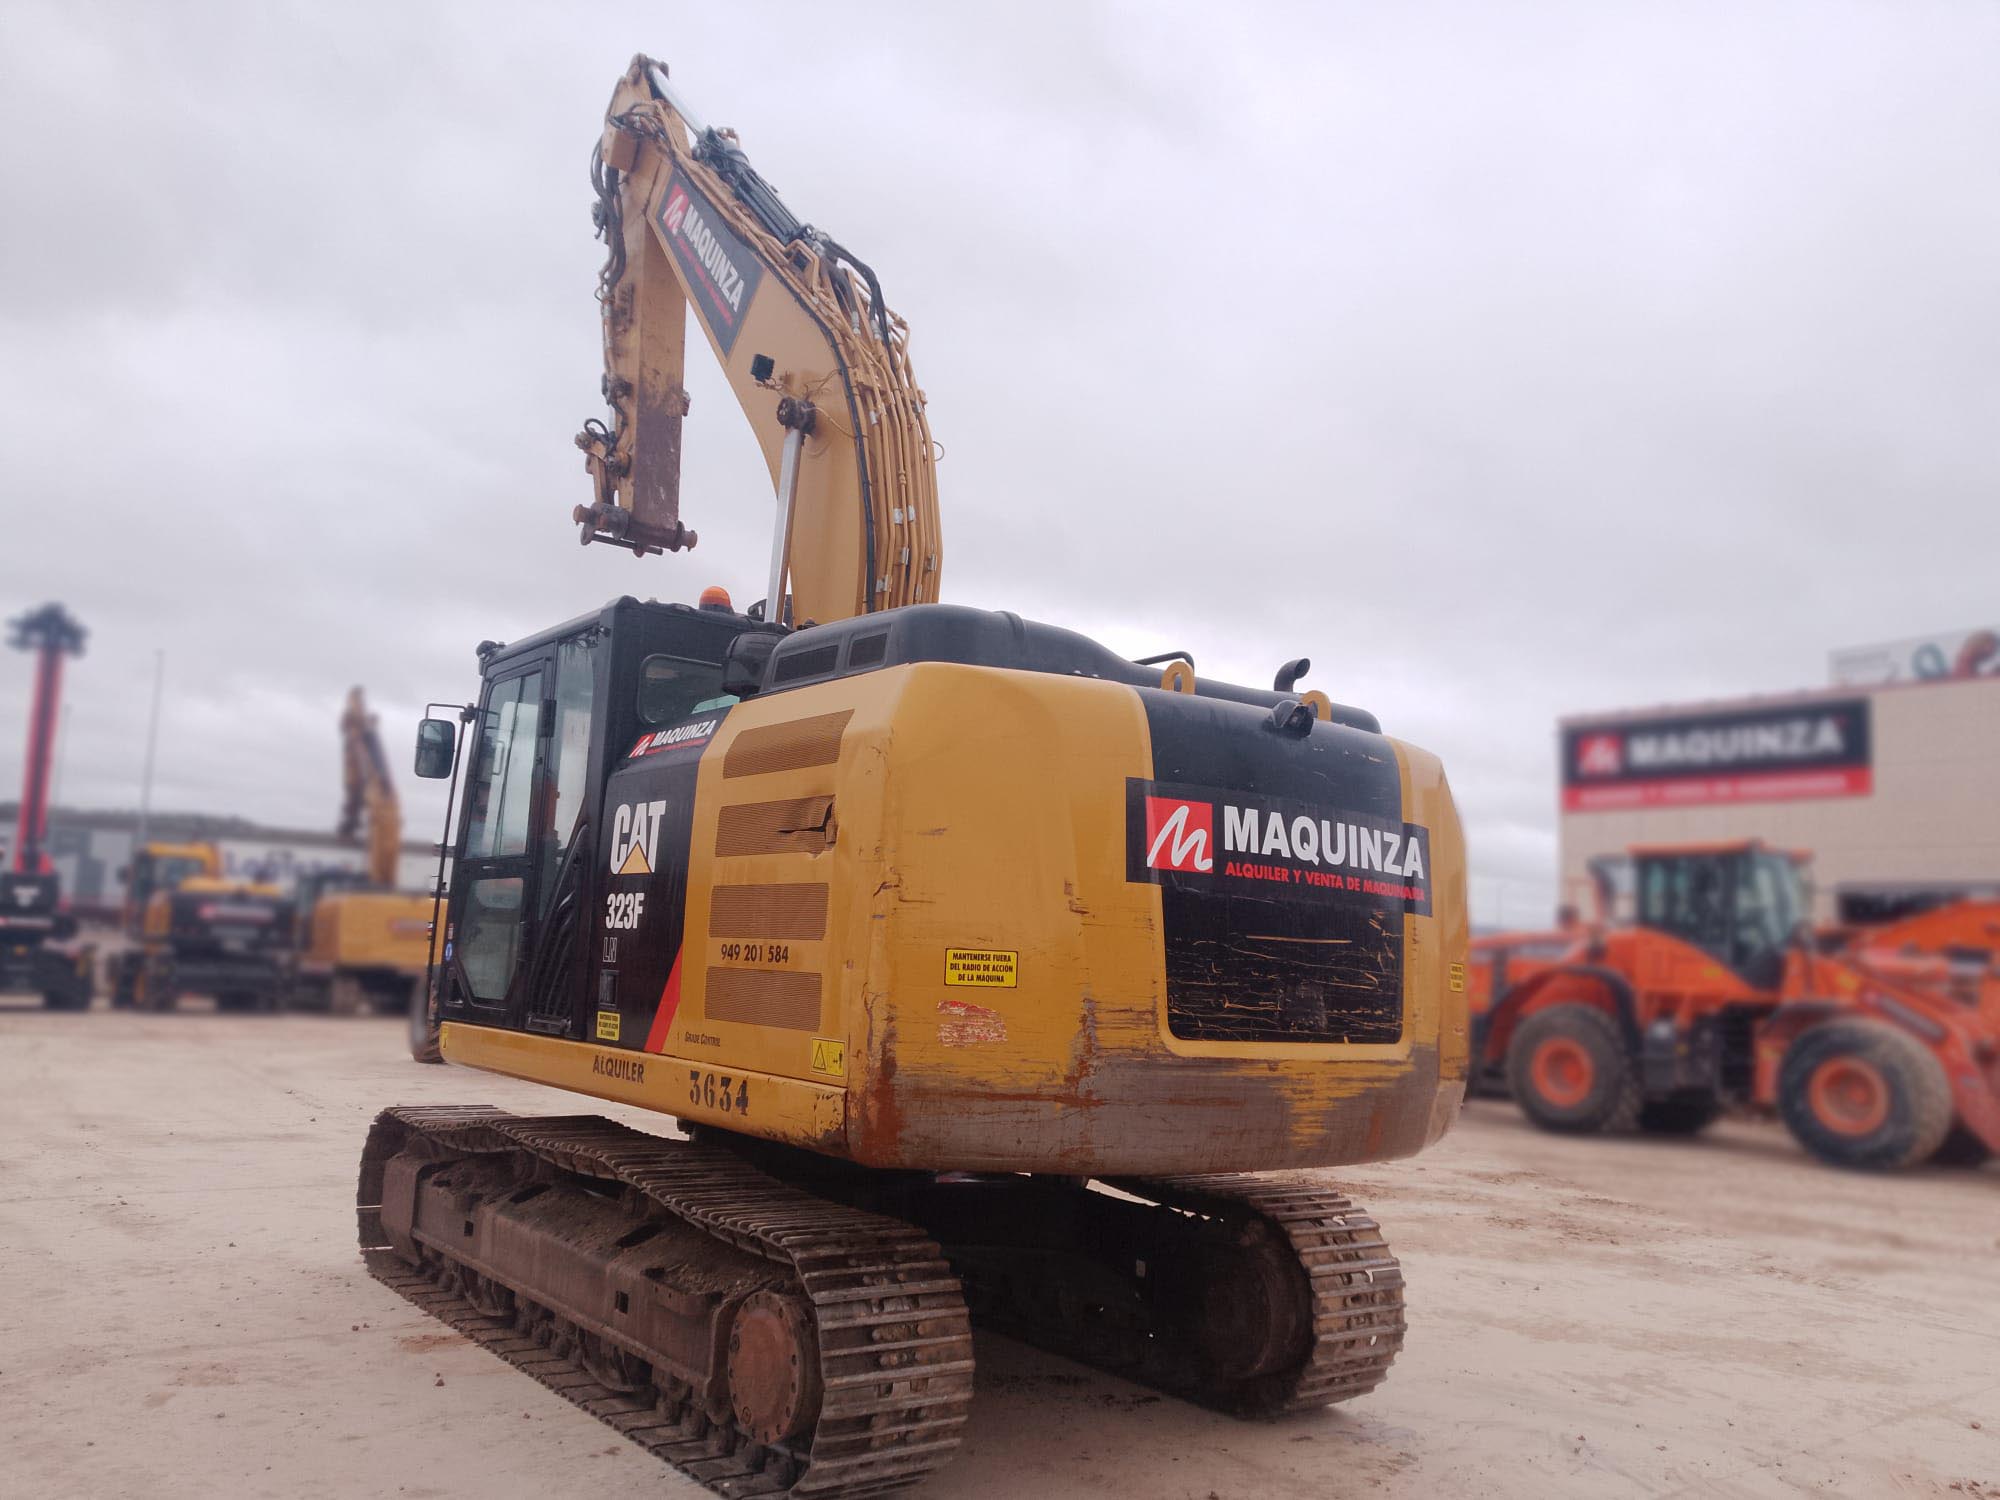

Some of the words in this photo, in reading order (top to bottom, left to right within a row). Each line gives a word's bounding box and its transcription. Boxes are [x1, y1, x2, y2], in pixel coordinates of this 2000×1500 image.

[682, 203, 745, 313] MAQUINZA
[650, 720, 717, 747] MAQUINZA
[1629, 716, 1844, 766] MAQUINZA
[610, 800, 666, 875] CAT
[1223, 805, 1424, 879] MAQUINZA
[1225, 862, 1289, 882] ALQUILER
[1293, 870, 1302, 884] Y
[1304, 871, 1344, 890] VENTA
[1347, 878, 1360, 891] DE
[605, 892, 644, 929] 323F
[721, 943, 740, 962] 949
[744, 944, 763, 962] 201
[768, 945, 789, 964] 584
[950, 963, 960, 971] DEL
[962, 963, 981, 972] RADIO
[983, 964, 991, 972] DE
[953, 952, 991, 961] MANTENERSE
[993, 954, 1011, 962] FUERA
[958, 974, 965, 982] DE
[967, 974, 974, 982] LA
[593, 1056, 644, 1083] ALQUILER
[689, 1070, 749, 1116] 3634
